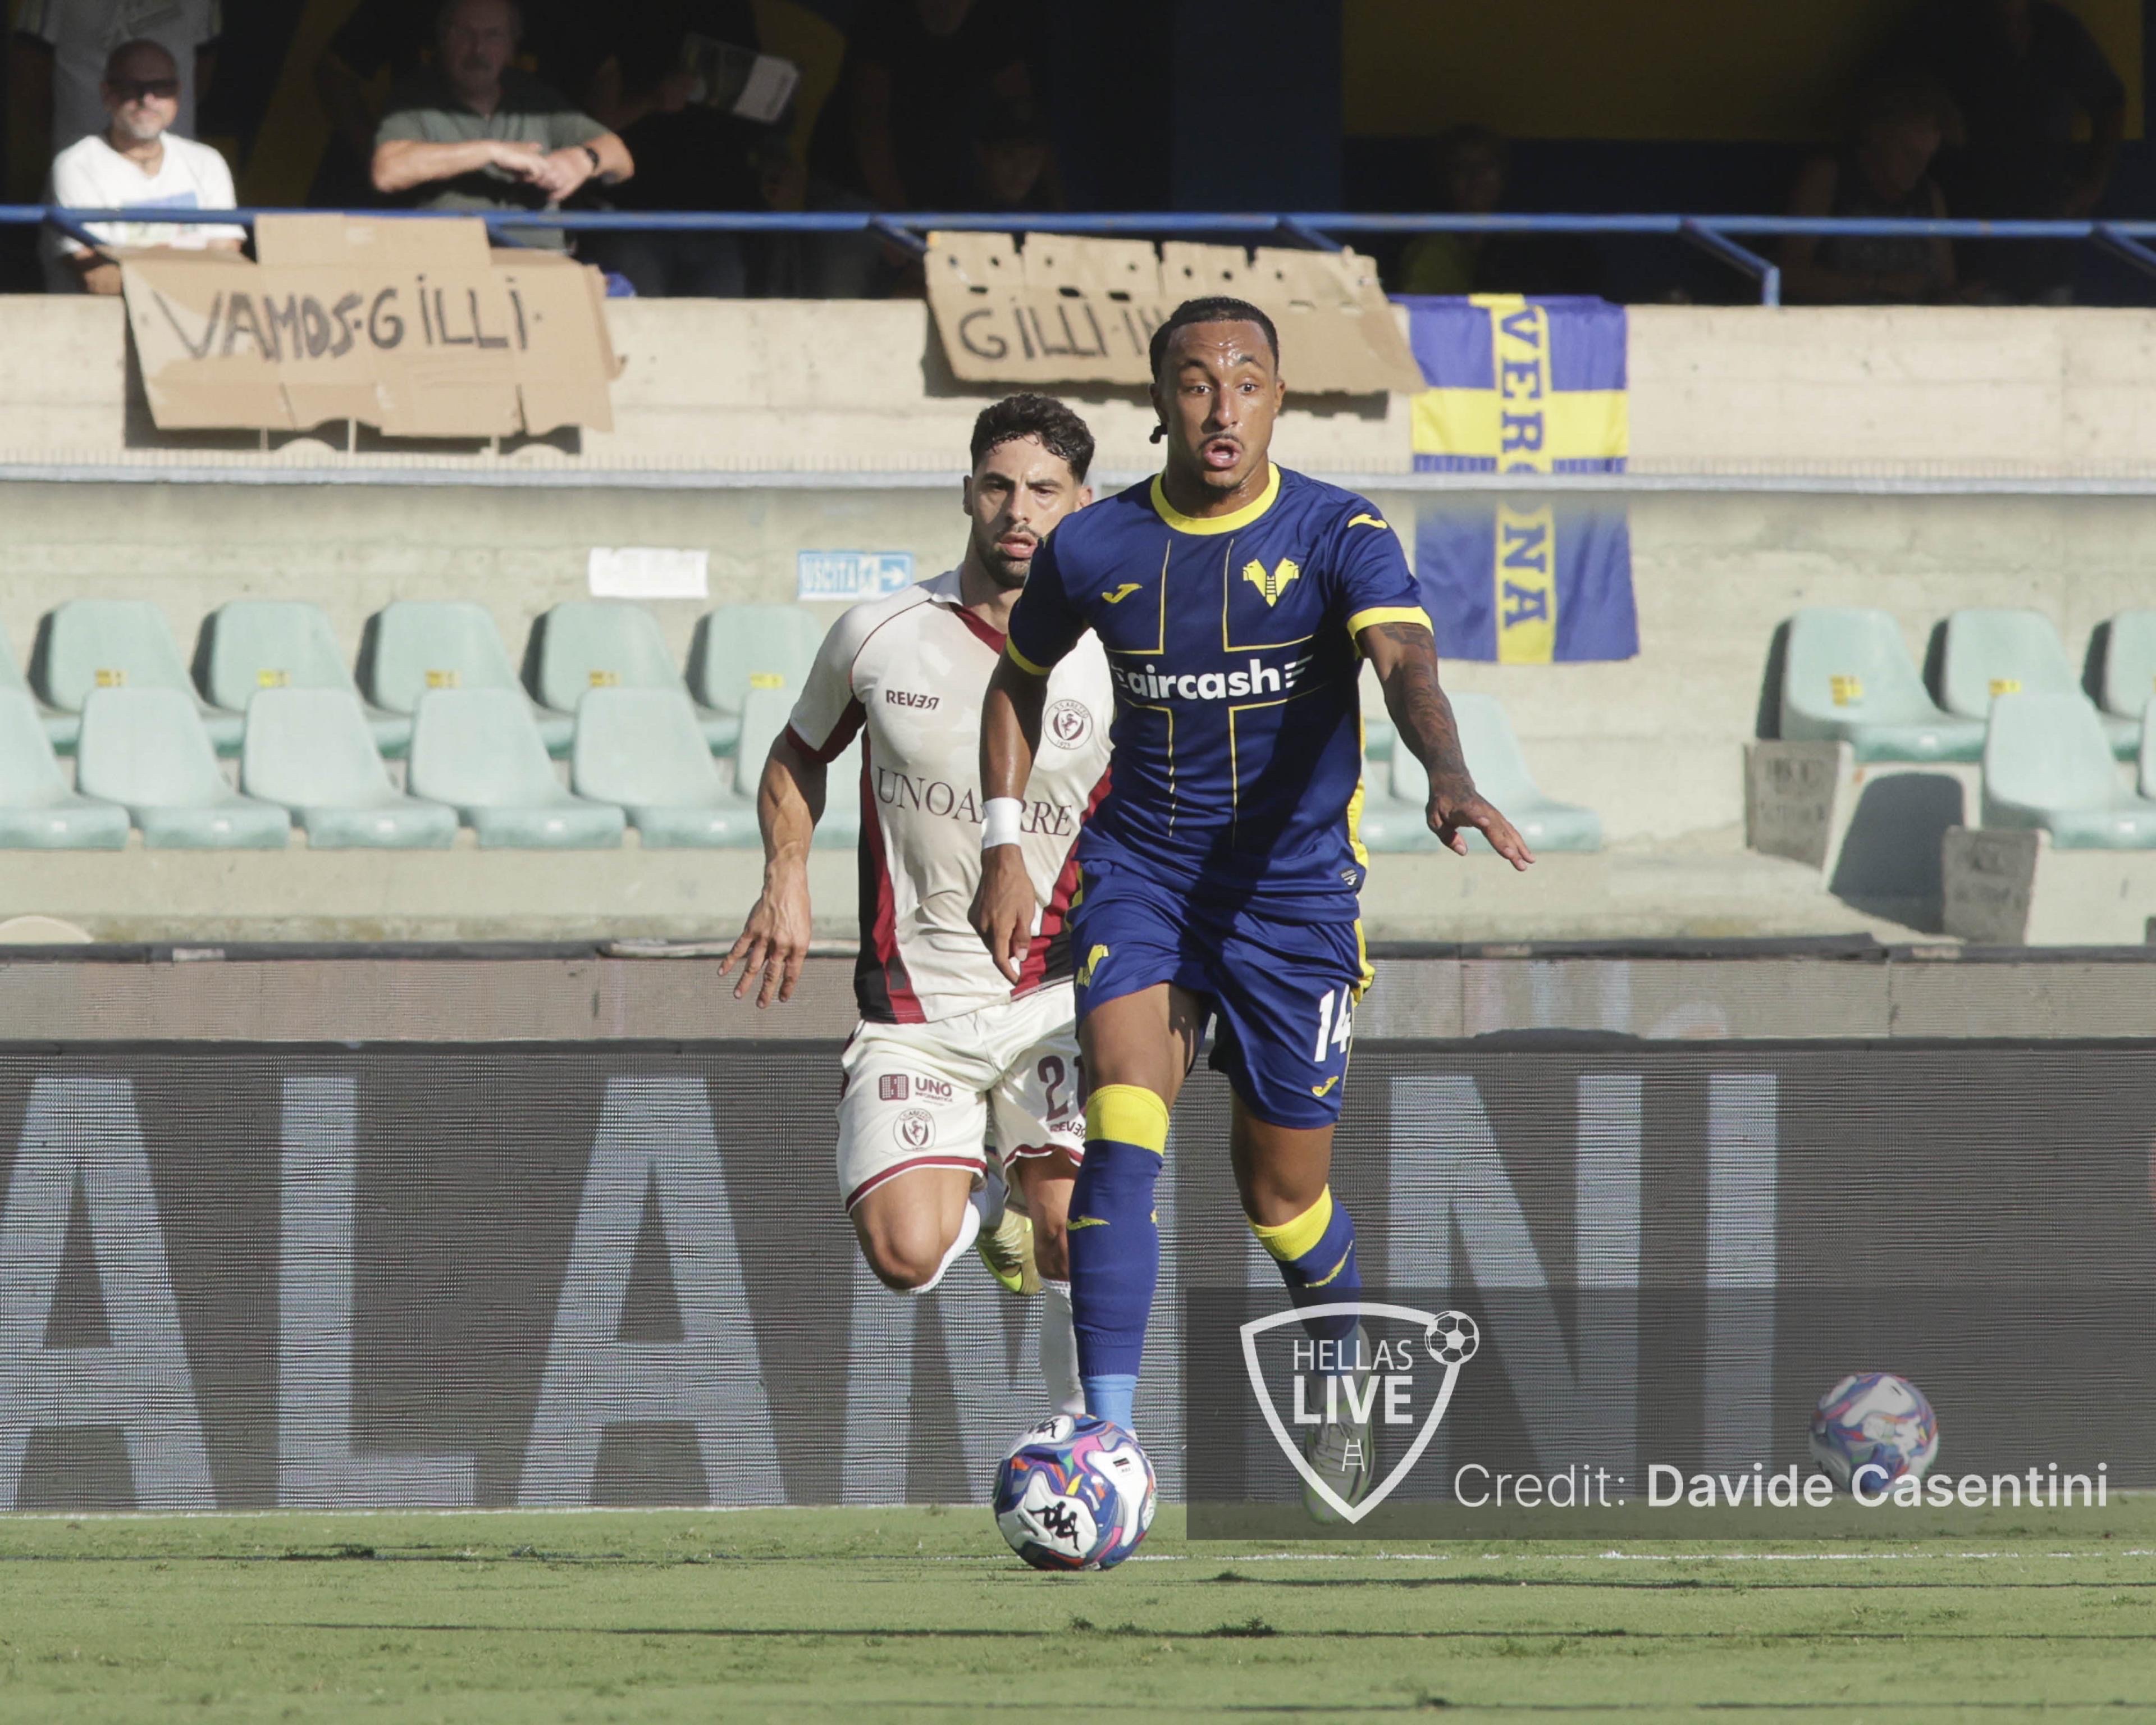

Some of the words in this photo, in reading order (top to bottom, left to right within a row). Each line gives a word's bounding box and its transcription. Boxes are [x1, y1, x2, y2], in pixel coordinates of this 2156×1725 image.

[1127, 658, 1281, 701] aircash
[1313, 984, 1351, 1062] 14
[915, 1076, 953, 1098] UNO
